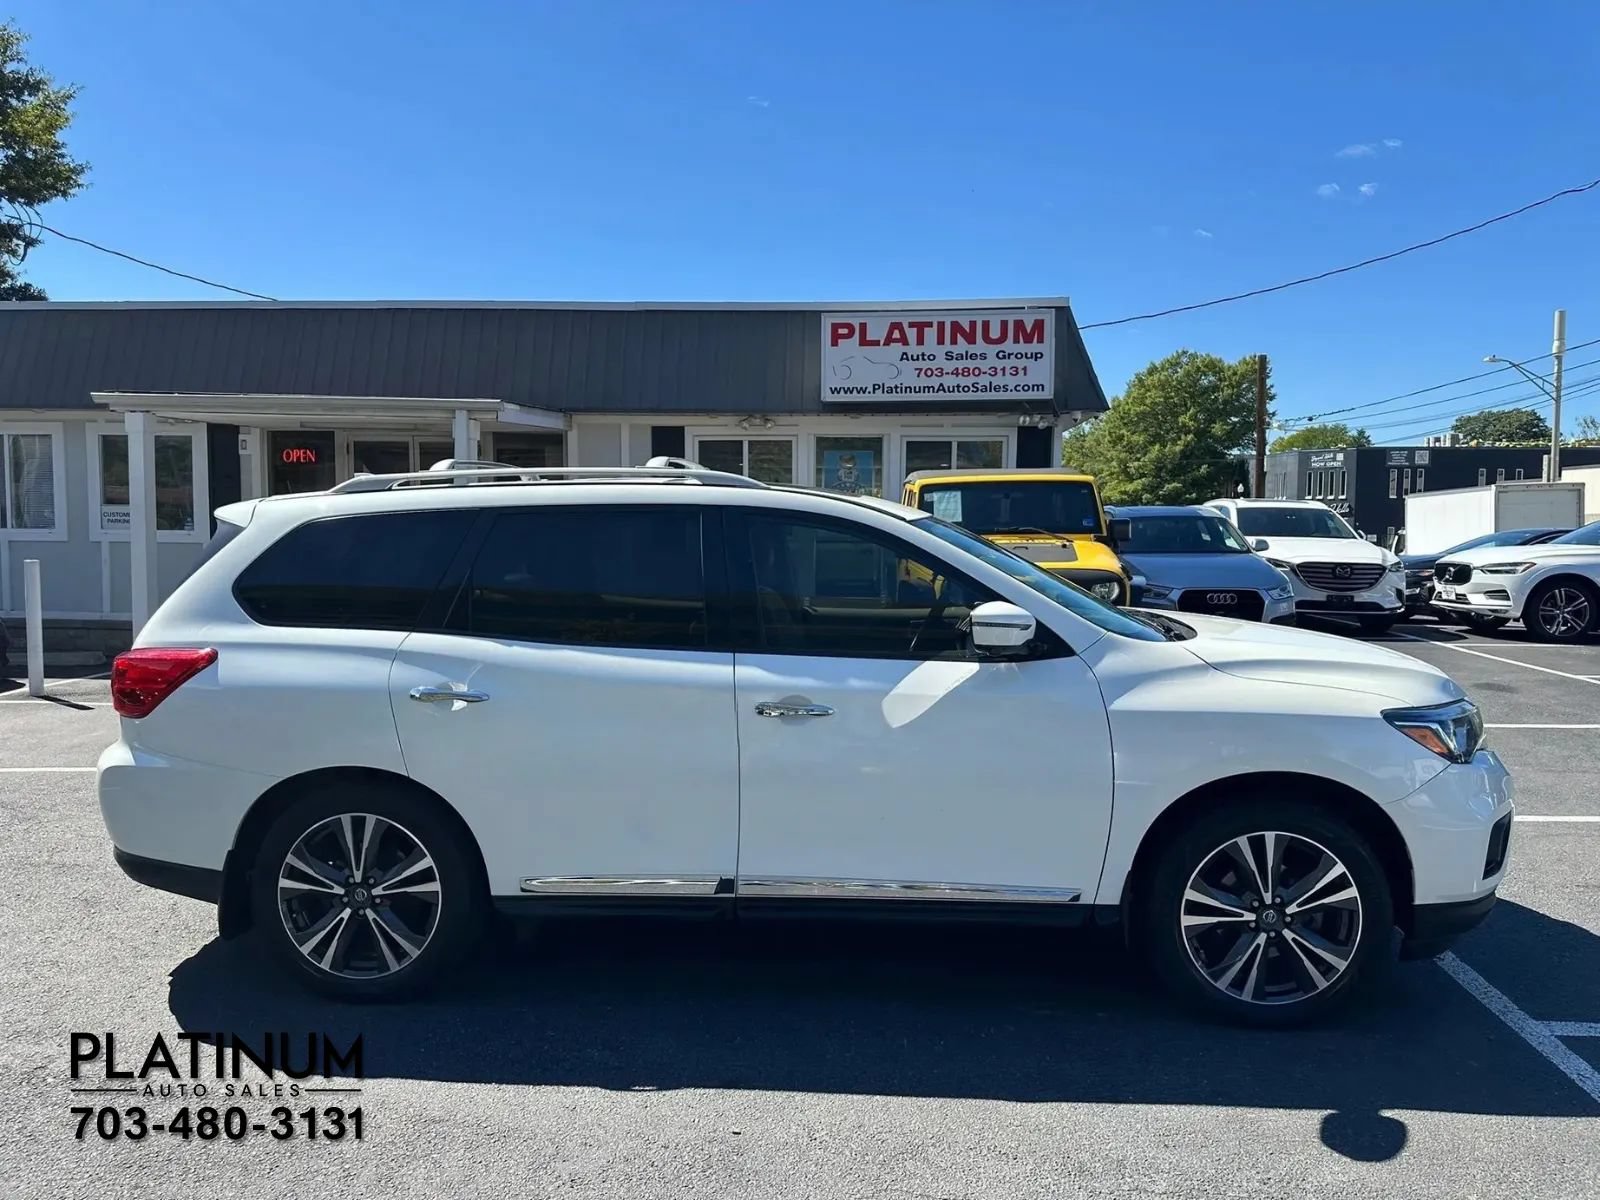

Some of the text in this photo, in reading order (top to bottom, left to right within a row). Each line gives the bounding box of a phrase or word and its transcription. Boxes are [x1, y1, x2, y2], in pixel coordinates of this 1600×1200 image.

[830, 319, 1045, 347] PLATINUM
[899, 350, 1044, 362] Auto Sales Group
[914, 366, 1028, 378] 703-480-3131
[829, 381, 1045, 395] www.PlatinumAutoSales.com
[282, 448, 316, 463] OPEN
